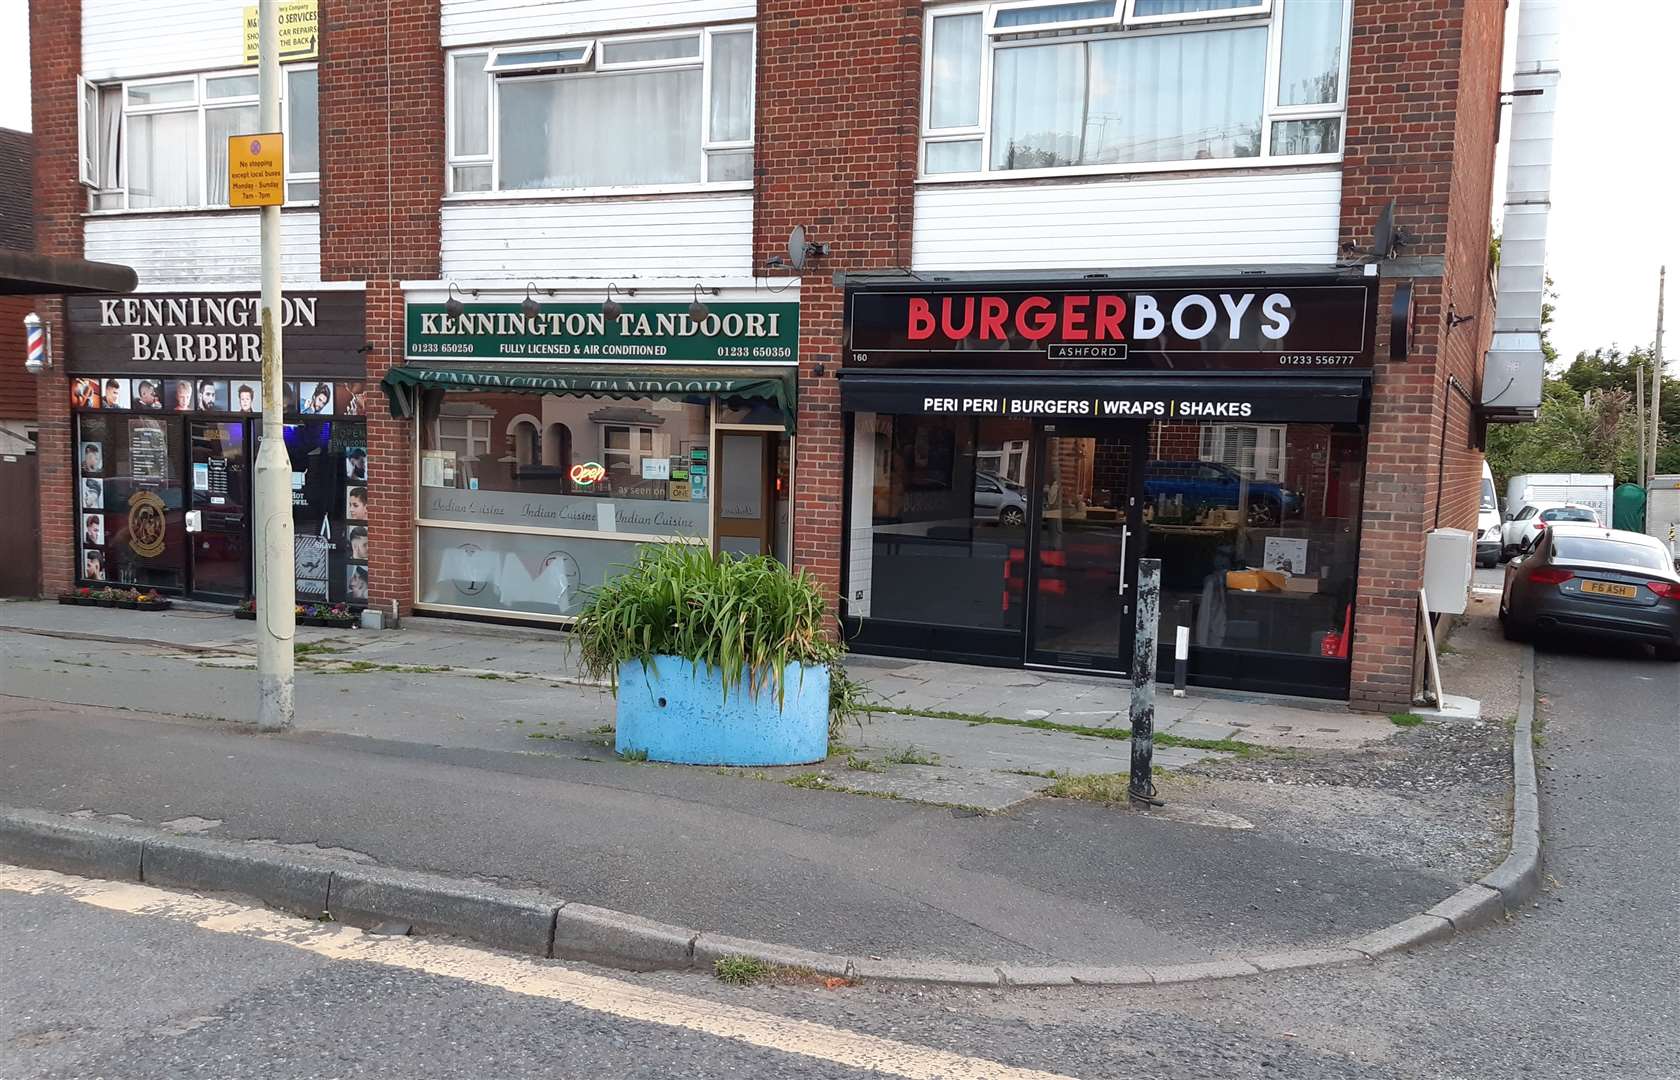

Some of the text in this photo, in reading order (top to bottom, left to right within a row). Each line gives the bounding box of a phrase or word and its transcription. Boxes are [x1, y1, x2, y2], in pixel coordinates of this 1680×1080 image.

[286, 11, 317, 23] SERVICES
[247, 25, 317, 41] SHO CAR REPAIRS
[247, 37, 309, 50] MOV THE BACK
[249, 160, 273, 168] stopping
[232, 171, 250, 179] except
[259, 191, 271, 199] 7pm
[420, 312, 780, 337] KENNINGTON TANDOORI
[412, 343, 474, 354] 01233 650250
[500, 343, 667, 356] FULLY LICENSED & AIR CONDITIONED
[717, 346, 791, 358] 01233 650350
[1058, 347, 1117, 357] ASHFORD
[852, 353, 868, 362] 160
[1279, 355, 1354, 366] 01233 556777
[923, 398, 1252, 417] PERI PERI BURGERS WRAPS SHAKES
[336, 438, 367, 448] Welcom
[570, 464, 606, 482] Open
[618, 486, 628, 495] as
[631, 486, 650, 496] seen
[653, 487, 665, 496] on
[521, 503, 597, 522] Indian Cuisine
[615, 511, 695, 528] Indian Cuisine
[1592, 583, 1626, 595] F6 ASH
